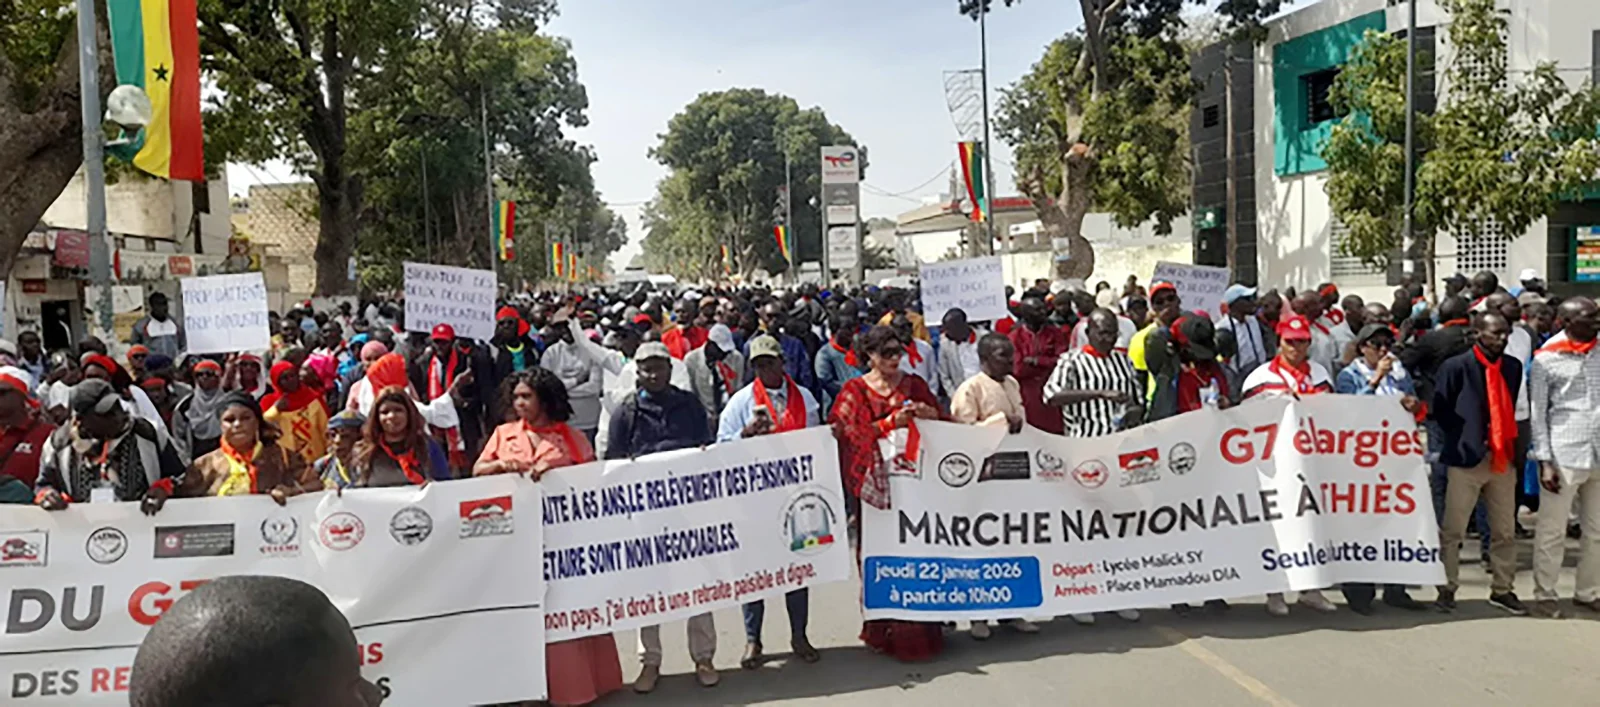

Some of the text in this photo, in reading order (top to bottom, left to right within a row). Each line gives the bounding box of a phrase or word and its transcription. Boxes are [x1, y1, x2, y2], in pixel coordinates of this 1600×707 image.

[1219, 423, 1279, 465] G7
[582, 490, 599, 519] 65
[646, 470, 722, 511] RELÈVEMENT
[725, 466, 747, 497] DES
[800, 454, 813, 482] ET
[899, 509, 1051, 546] MARCHE
[1061, 489, 1283, 543] NATIONALE
[1295, 473, 1321, 517] À
[589, 541, 622, 575] SONT
[624, 537, 654, 569] NON
[874, 561, 1023, 584] jeudi 22 janvier 2026
[1141, 554, 1185, 569] Malick
[1186, 550, 1204, 563] SY
[627, 592, 657, 617] droit
[668, 591, 690, 611] une
[693, 580, 733, 605] retraite
[734, 569, 774, 601] paisible
[775, 566, 787, 585] et
[951, 587, 968, 604] de
[968, 585, 1013, 604] 10h00
[1106, 578, 1142, 593] Place
[1143, 572, 1211, 590] Mamadou
[5, 584, 105, 634] DU
[12, 669, 79, 698] DES
